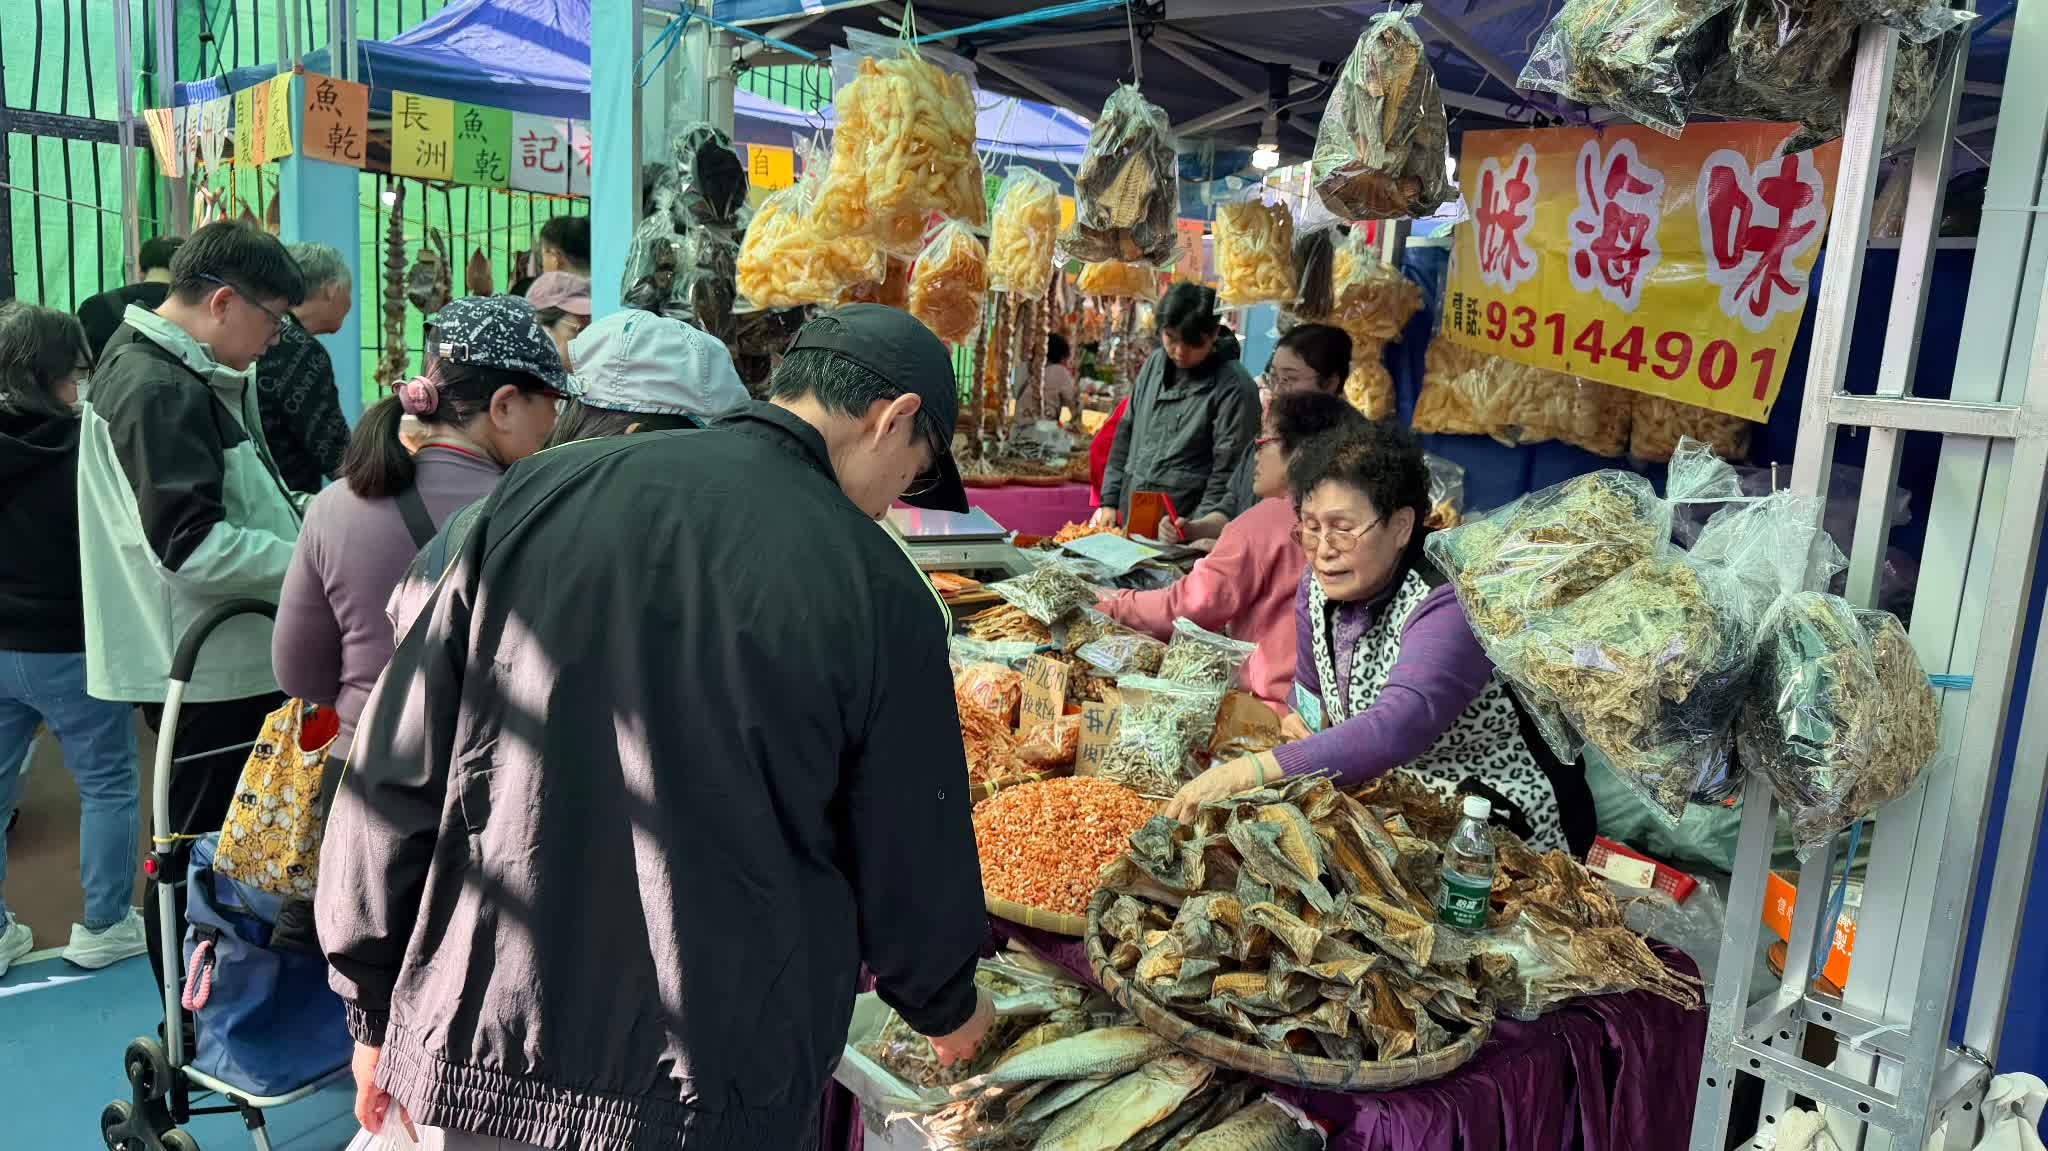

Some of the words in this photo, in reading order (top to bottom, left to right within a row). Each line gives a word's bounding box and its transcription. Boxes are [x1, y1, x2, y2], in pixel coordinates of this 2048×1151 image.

[309, 79, 361, 160] 魚乾
[399, 96, 447, 172] 長洲
[458, 108, 505, 182] 魚乾
[519, 129, 565, 174] 記
[1485, 300, 1777, 401] 93144901
